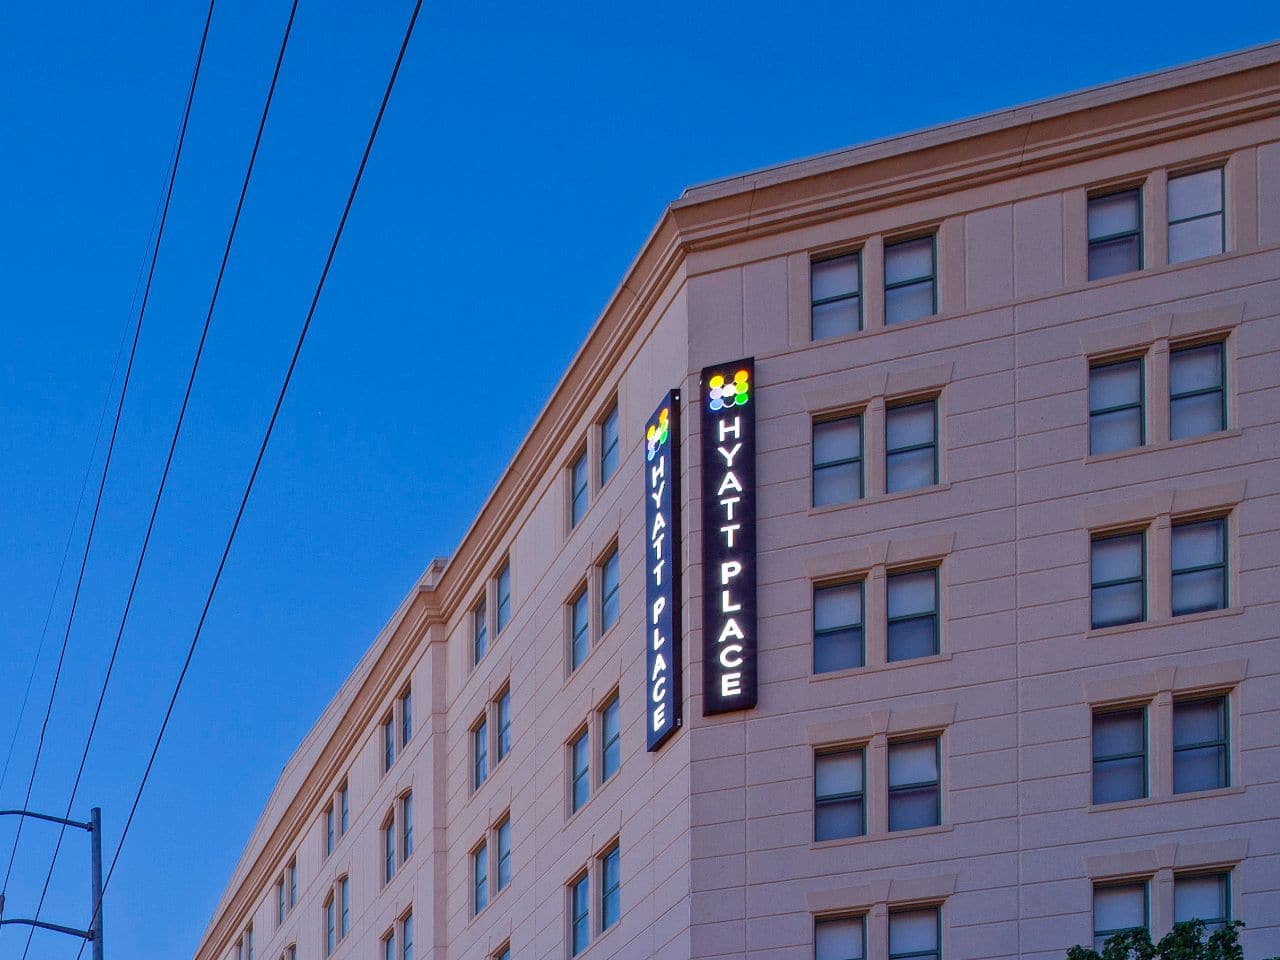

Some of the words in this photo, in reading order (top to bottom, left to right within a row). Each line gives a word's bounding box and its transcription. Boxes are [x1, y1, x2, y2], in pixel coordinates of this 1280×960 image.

[652, 455, 665, 586] HYATT
[717, 418, 743, 548] HYATT
[652, 596, 666, 732] PLACE
[718, 560, 745, 697] PLACE
